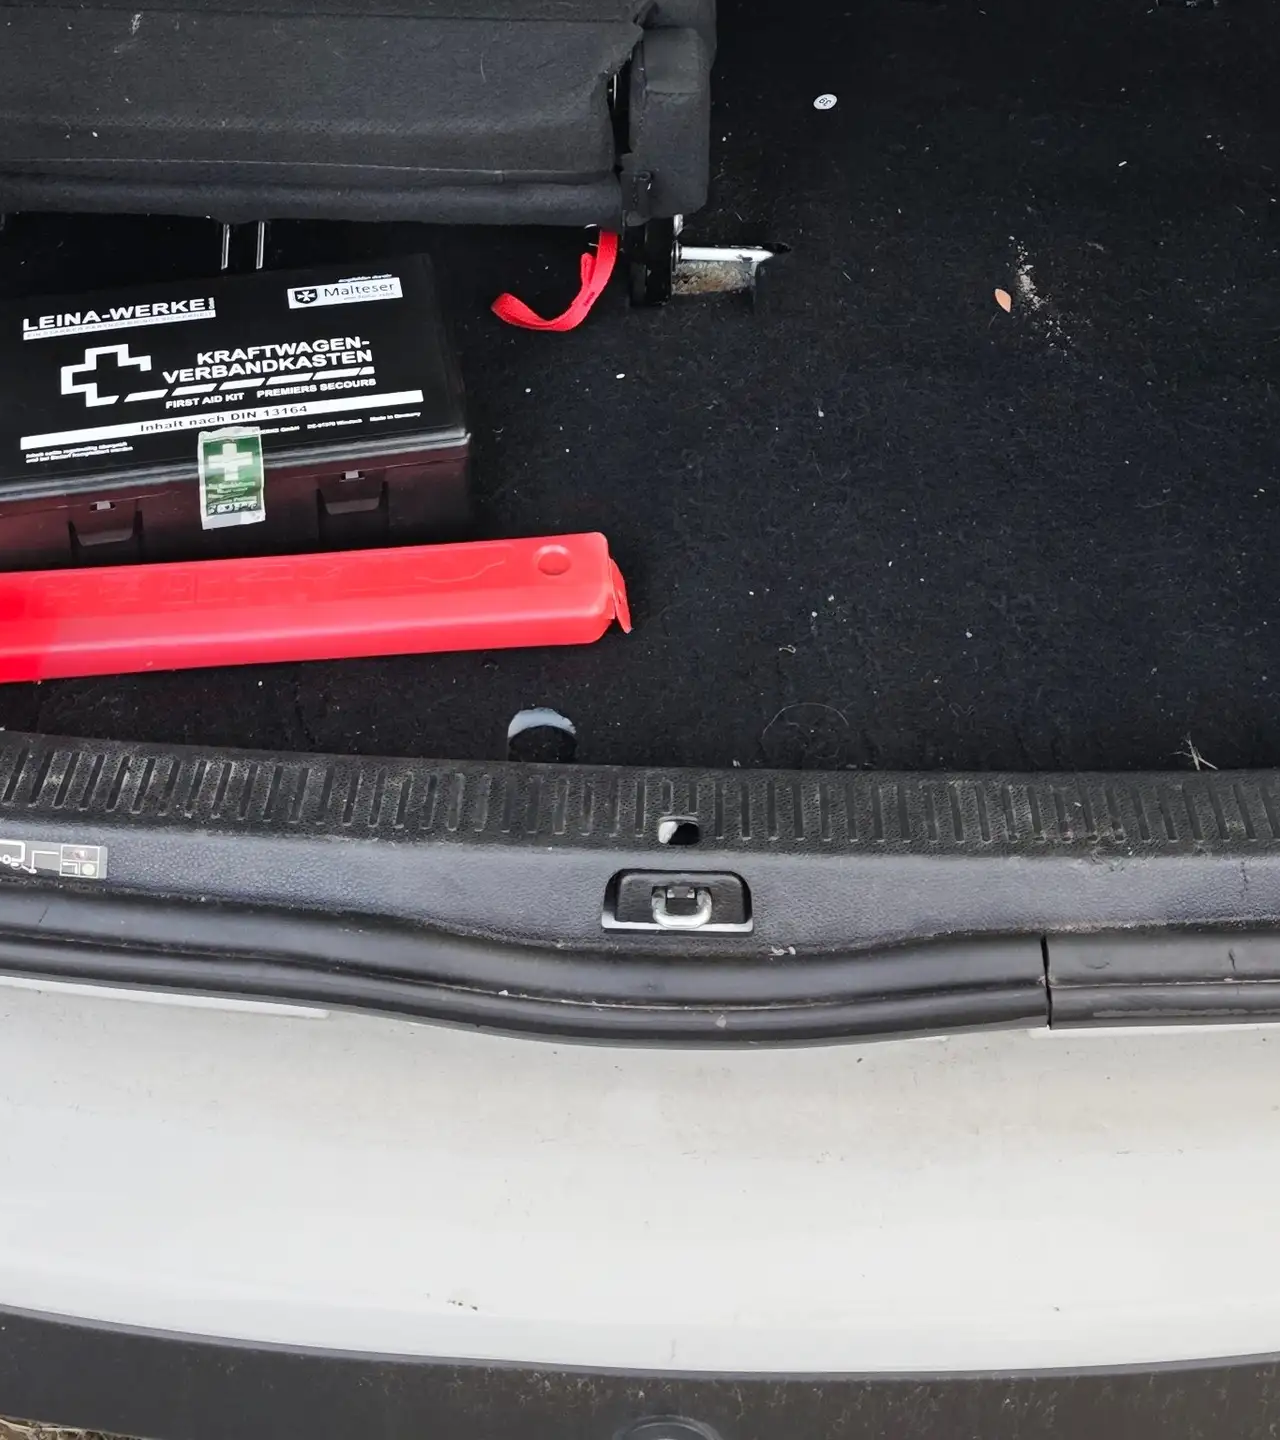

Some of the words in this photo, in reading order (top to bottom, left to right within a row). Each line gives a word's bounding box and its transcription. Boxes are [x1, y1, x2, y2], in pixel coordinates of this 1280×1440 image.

[324, 283, 395, 297] Malteser
[23, 298, 206, 331] LEINA-WERKE
[197, 336, 370, 365] KRAFTWAGEN-
[162, 349, 373, 384] VERBANDKASTEN
[165, 398, 200, 409] FIRST
[202, 395, 223, 405] AID
[225, 392, 245, 402] KIT
[256, 381, 317, 398] PREMIERS
[319, 378, 377, 392] SECOURS
[140, 420, 183, 432] Inhalt
[189, 415, 225, 426] nach
[231, 411, 257, 421] DIN
[264, 405, 308, 417] 13164
